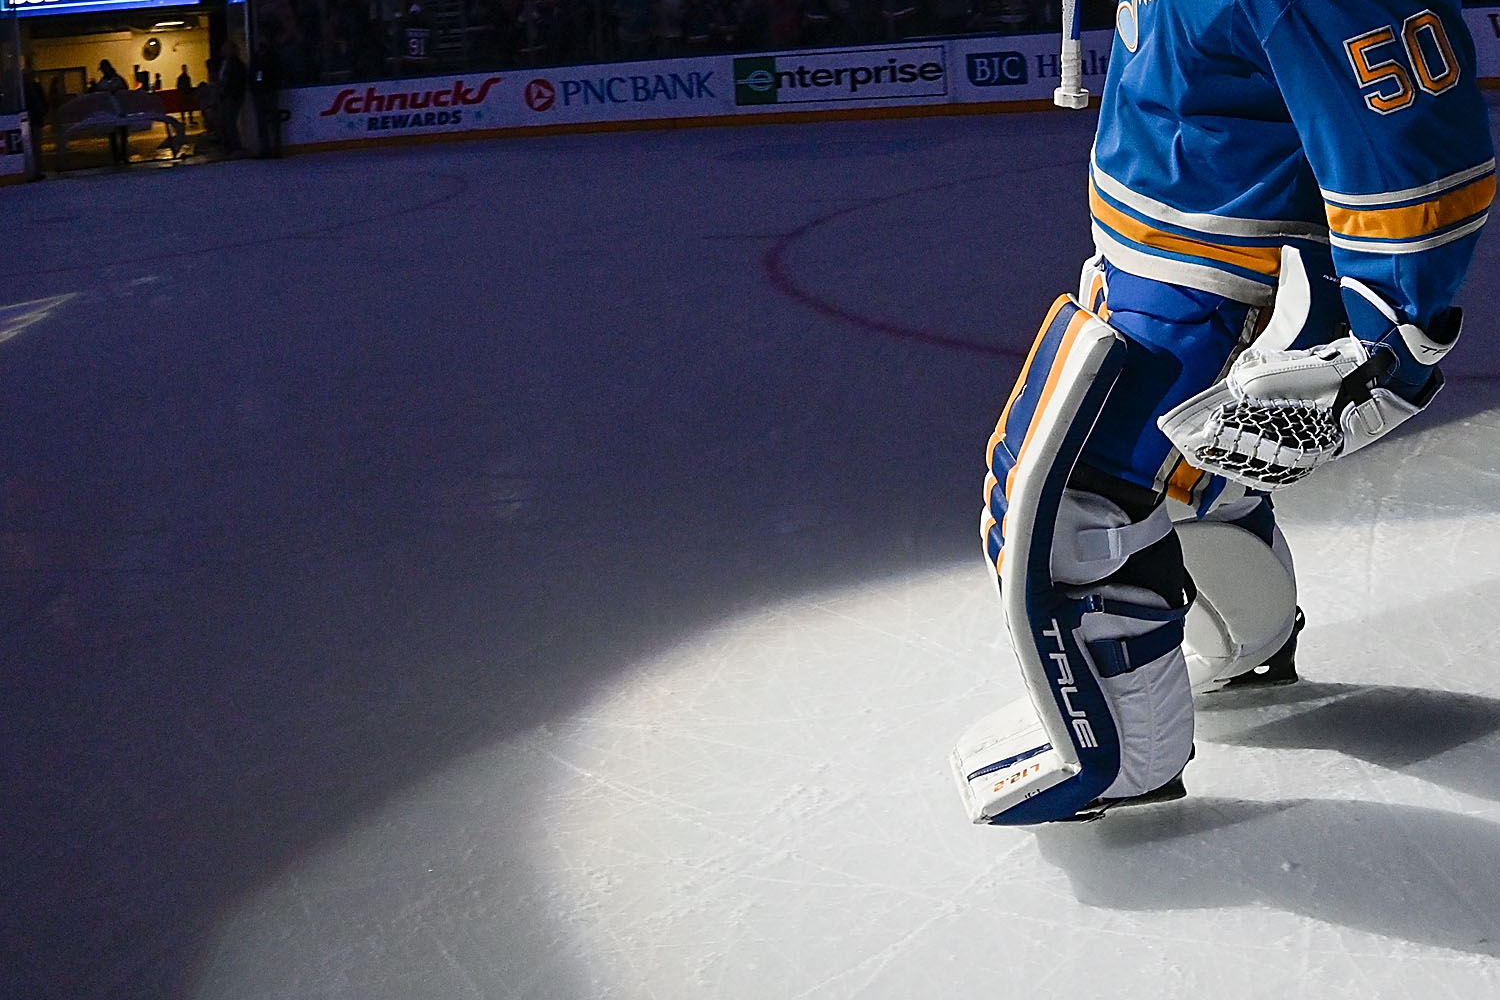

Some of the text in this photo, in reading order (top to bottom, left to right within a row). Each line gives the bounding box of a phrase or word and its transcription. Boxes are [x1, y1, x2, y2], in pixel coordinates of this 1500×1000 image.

[748, 57, 944, 92] enterprise
[973, 56, 1022, 84] BJC
[1343, 9, 1460, 115] 50
[320, 77, 503, 116] Schnucks
[367, 110, 462, 131] REWARDS
[1043, 618, 1099, 748] TRUE
